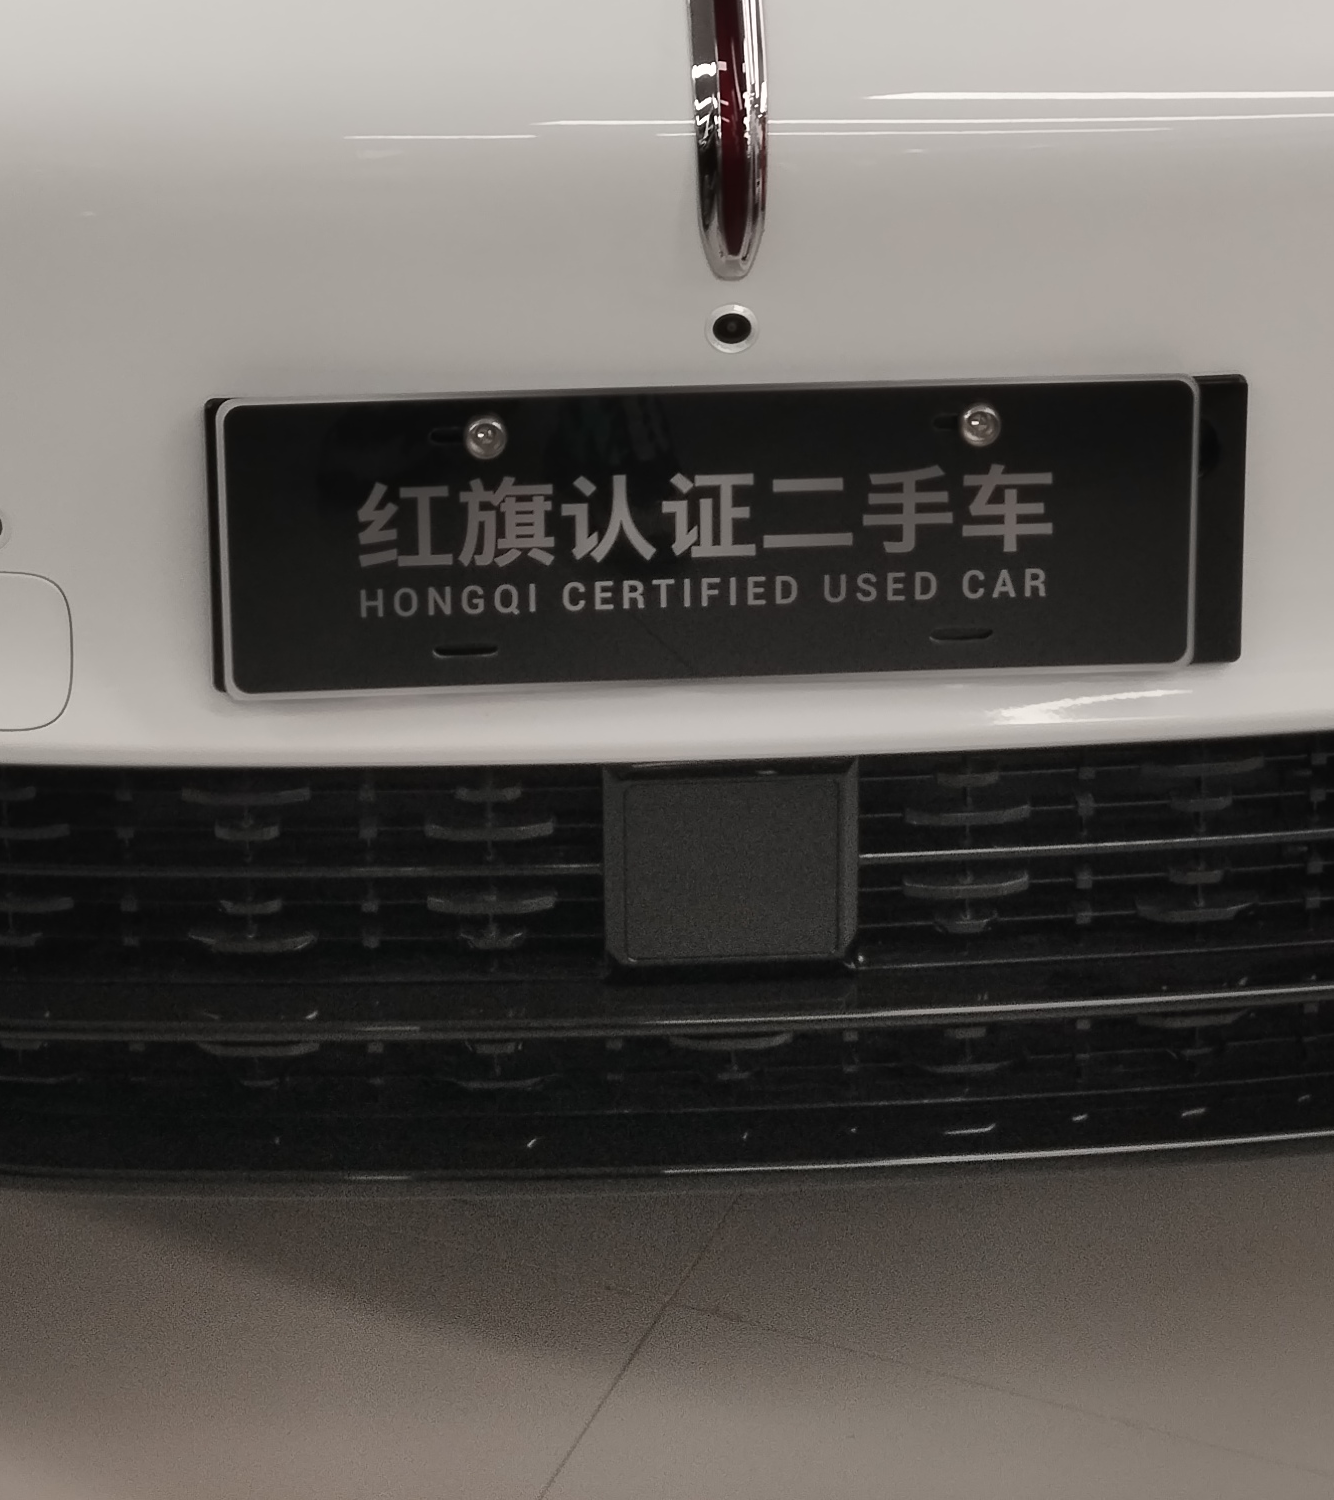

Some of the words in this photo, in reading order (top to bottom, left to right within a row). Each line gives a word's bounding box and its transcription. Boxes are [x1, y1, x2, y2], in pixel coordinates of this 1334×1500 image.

[357, 463, 1055, 570] 红旗认证二手车
[359, 578, 538, 618] HONGQI
[562, 574, 800, 612] CERTIFIED
[823, 572, 938, 605] USED
[960, 568, 1049, 601] CAR
